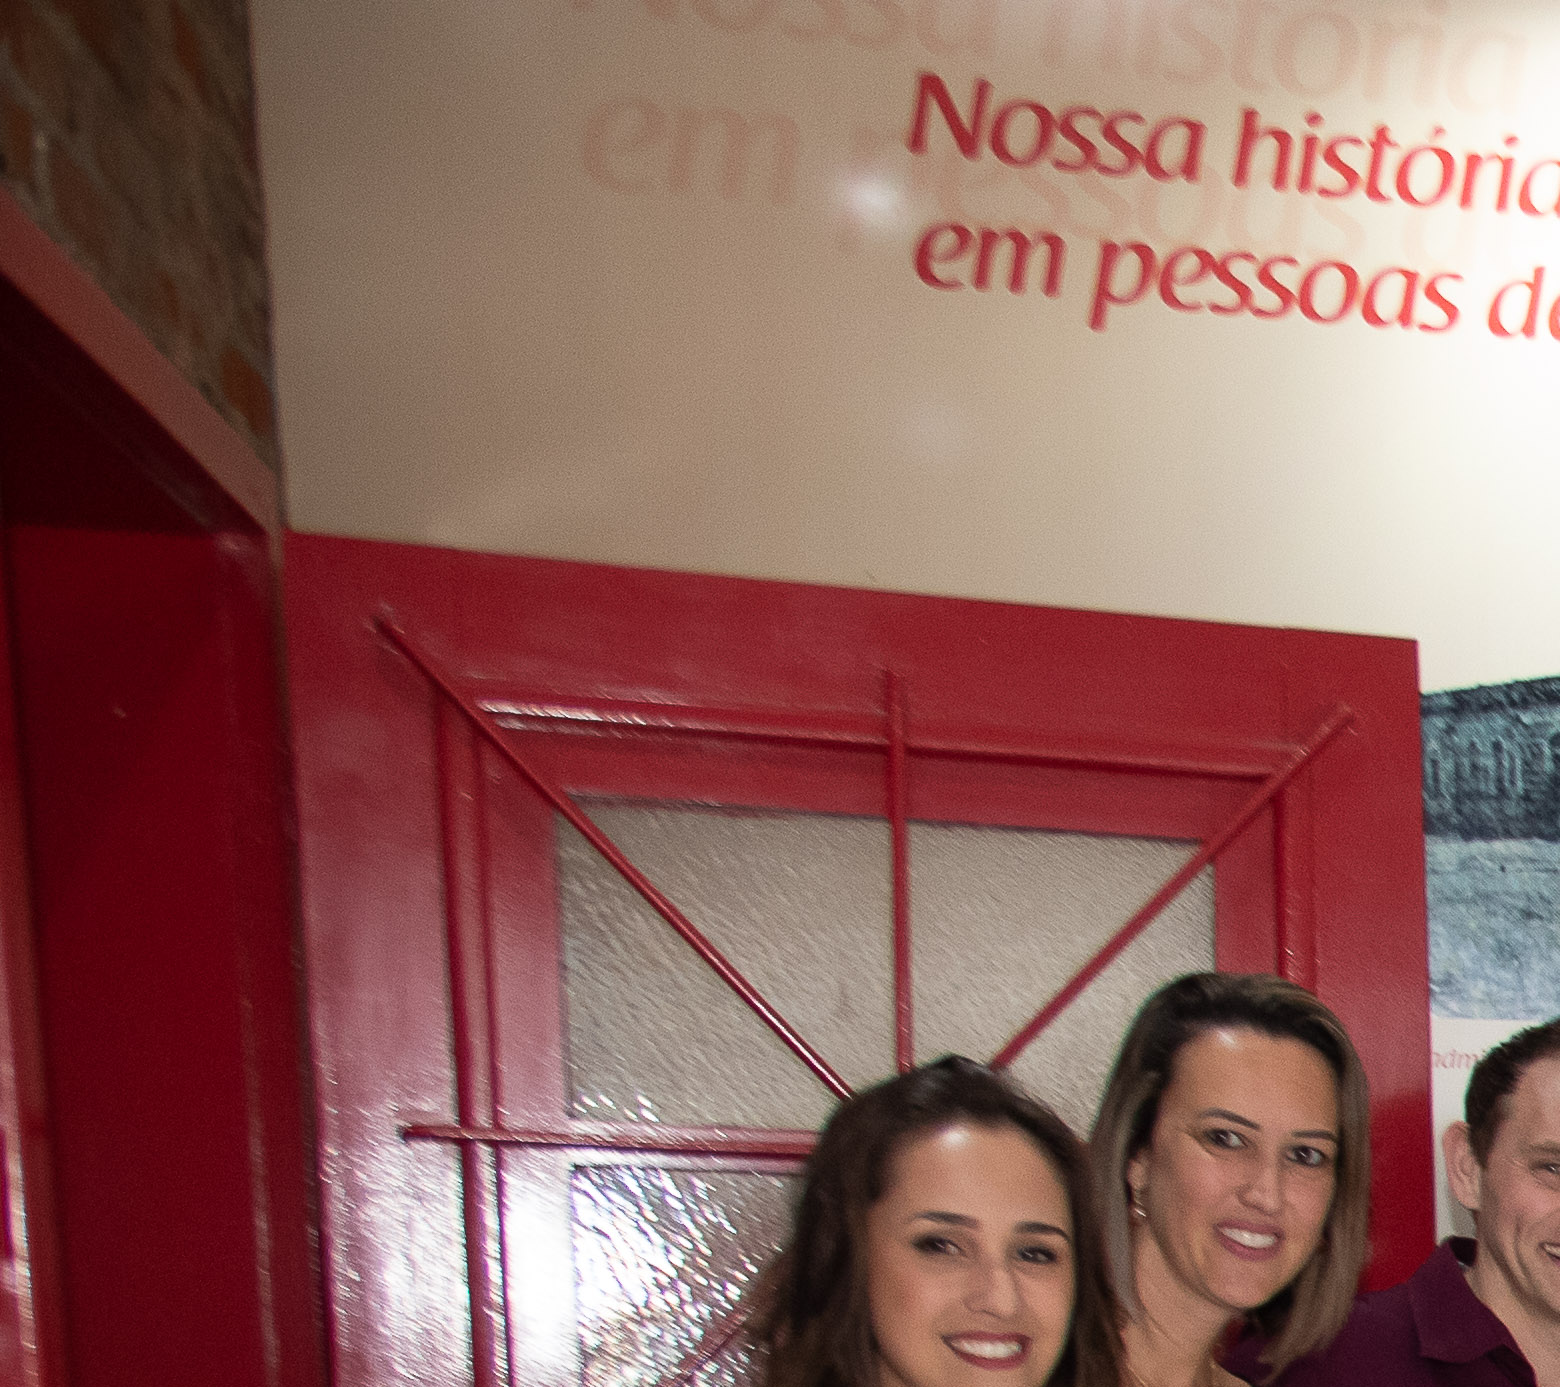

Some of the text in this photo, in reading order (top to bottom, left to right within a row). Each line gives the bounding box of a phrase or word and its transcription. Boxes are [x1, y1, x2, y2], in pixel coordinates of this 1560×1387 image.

[905, 70, 1204, 183] Nossa
[912, 220, 1066, 297] em
[1087, 237, 1462, 333] pessoas
